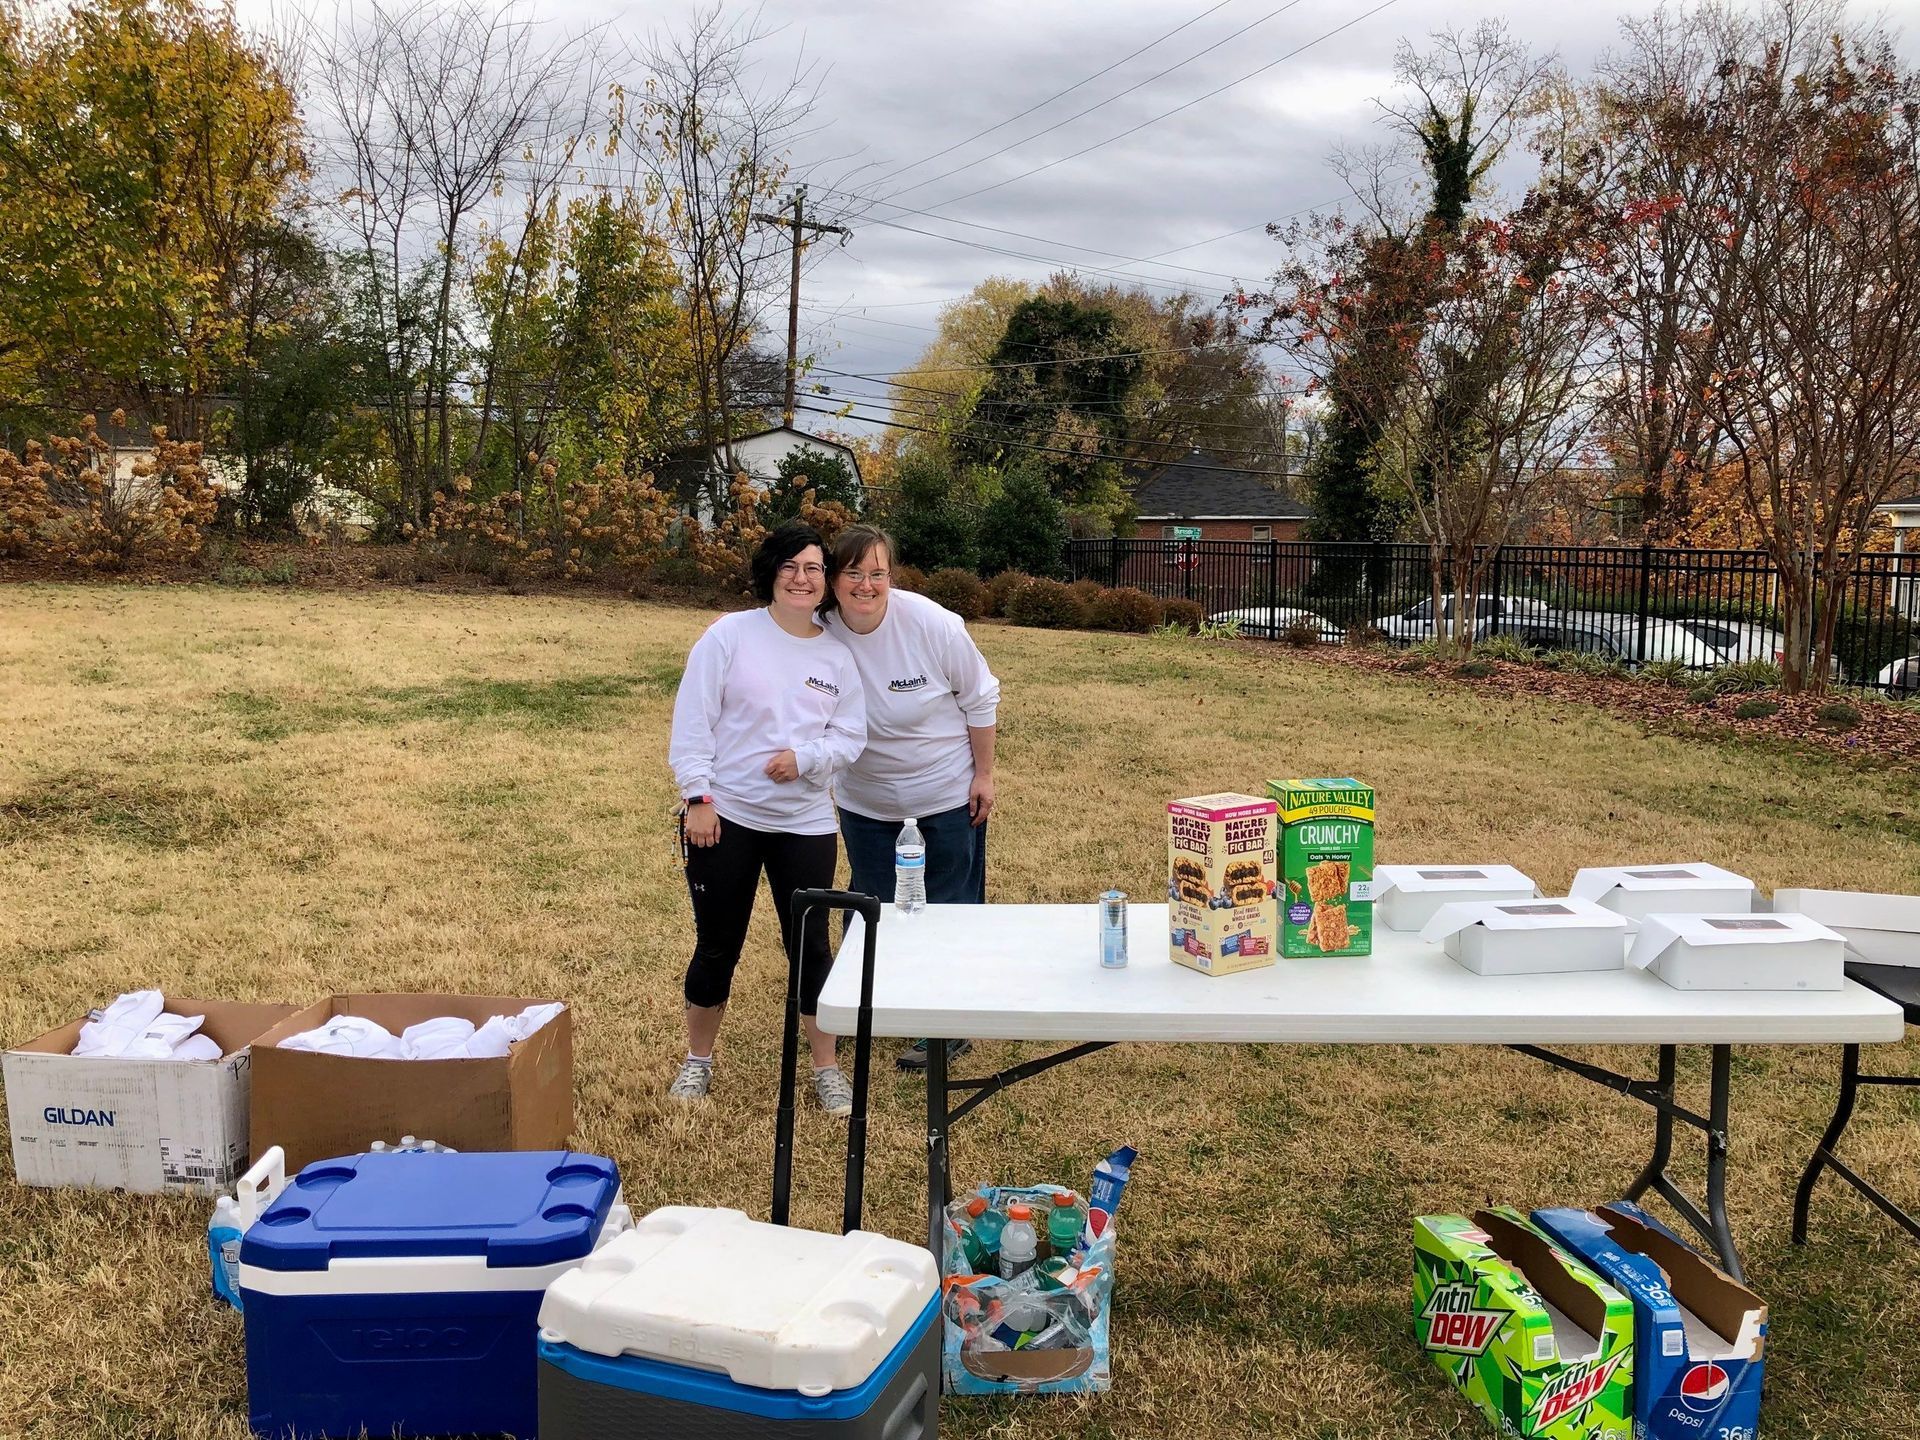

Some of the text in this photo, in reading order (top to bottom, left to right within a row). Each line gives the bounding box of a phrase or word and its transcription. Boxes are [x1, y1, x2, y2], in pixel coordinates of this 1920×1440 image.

[890, 675, 927, 688] McLain's
[1290, 791, 1371, 809] NATURE VALLEY
[1309, 806, 1351, 814] 49 POUCHES
[1172, 826, 1210, 842] BAKERY
[1226, 827, 1267, 842] BAKERY
[1300, 825, 1360, 844] CRUNCHY
[1176, 838, 1206, 854] FIG BAR
[1230, 840, 1263, 854] FIG BAR
[1264, 850, 1273, 860] 40
[44, 1107, 115, 1127] GILDAN
[1514, 1287, 1542, 1306] 36
[1640, 1281, 1671, 1300] 36
[1430, 1287, 1470, 1313] Mtn
[1538, 1363, 1588, 1406] Mtn
[1668, 1408, 1704, 1428] pepsi
